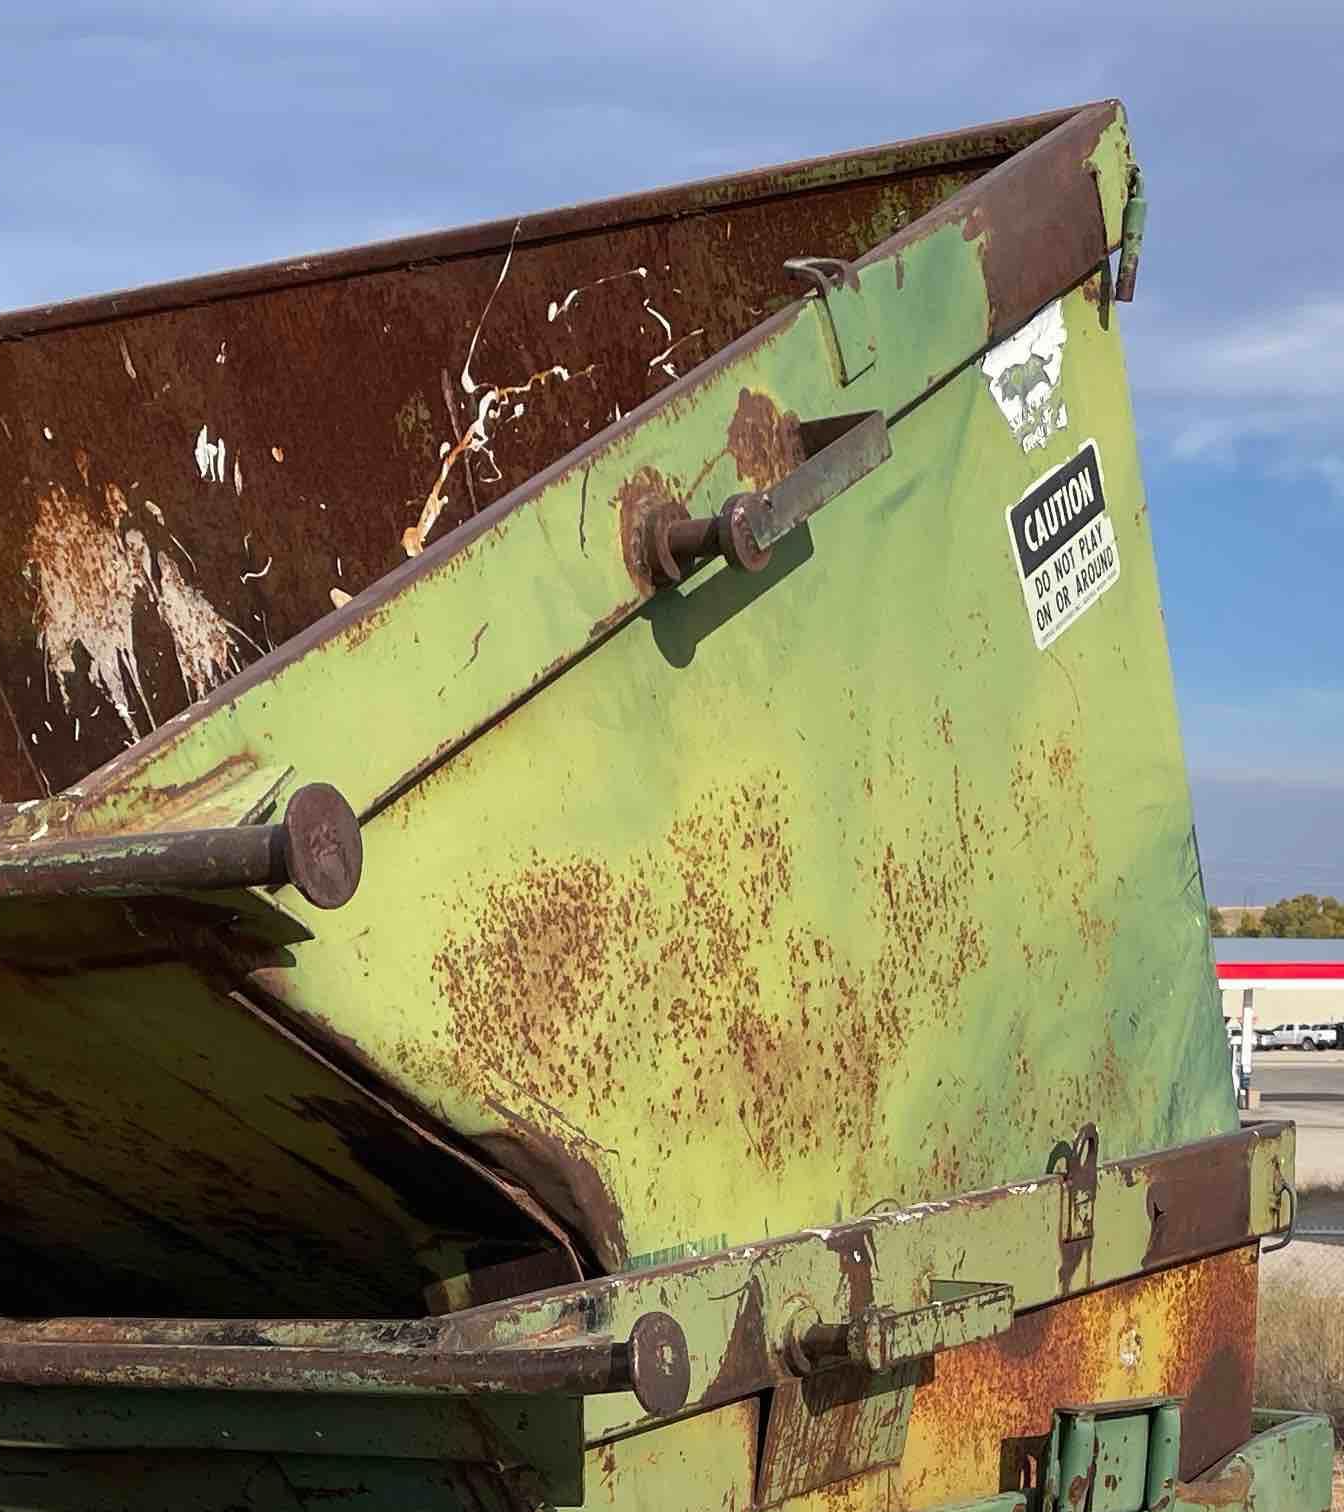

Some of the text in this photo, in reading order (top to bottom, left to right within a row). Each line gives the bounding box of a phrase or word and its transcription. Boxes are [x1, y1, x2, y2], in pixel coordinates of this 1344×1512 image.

[1024, 467, 1094, 552] CAUTION
[1035, 522, 1104, 600] DO NOT PLAY
[1036, 546, 1114, 631] ON OR AROUND
